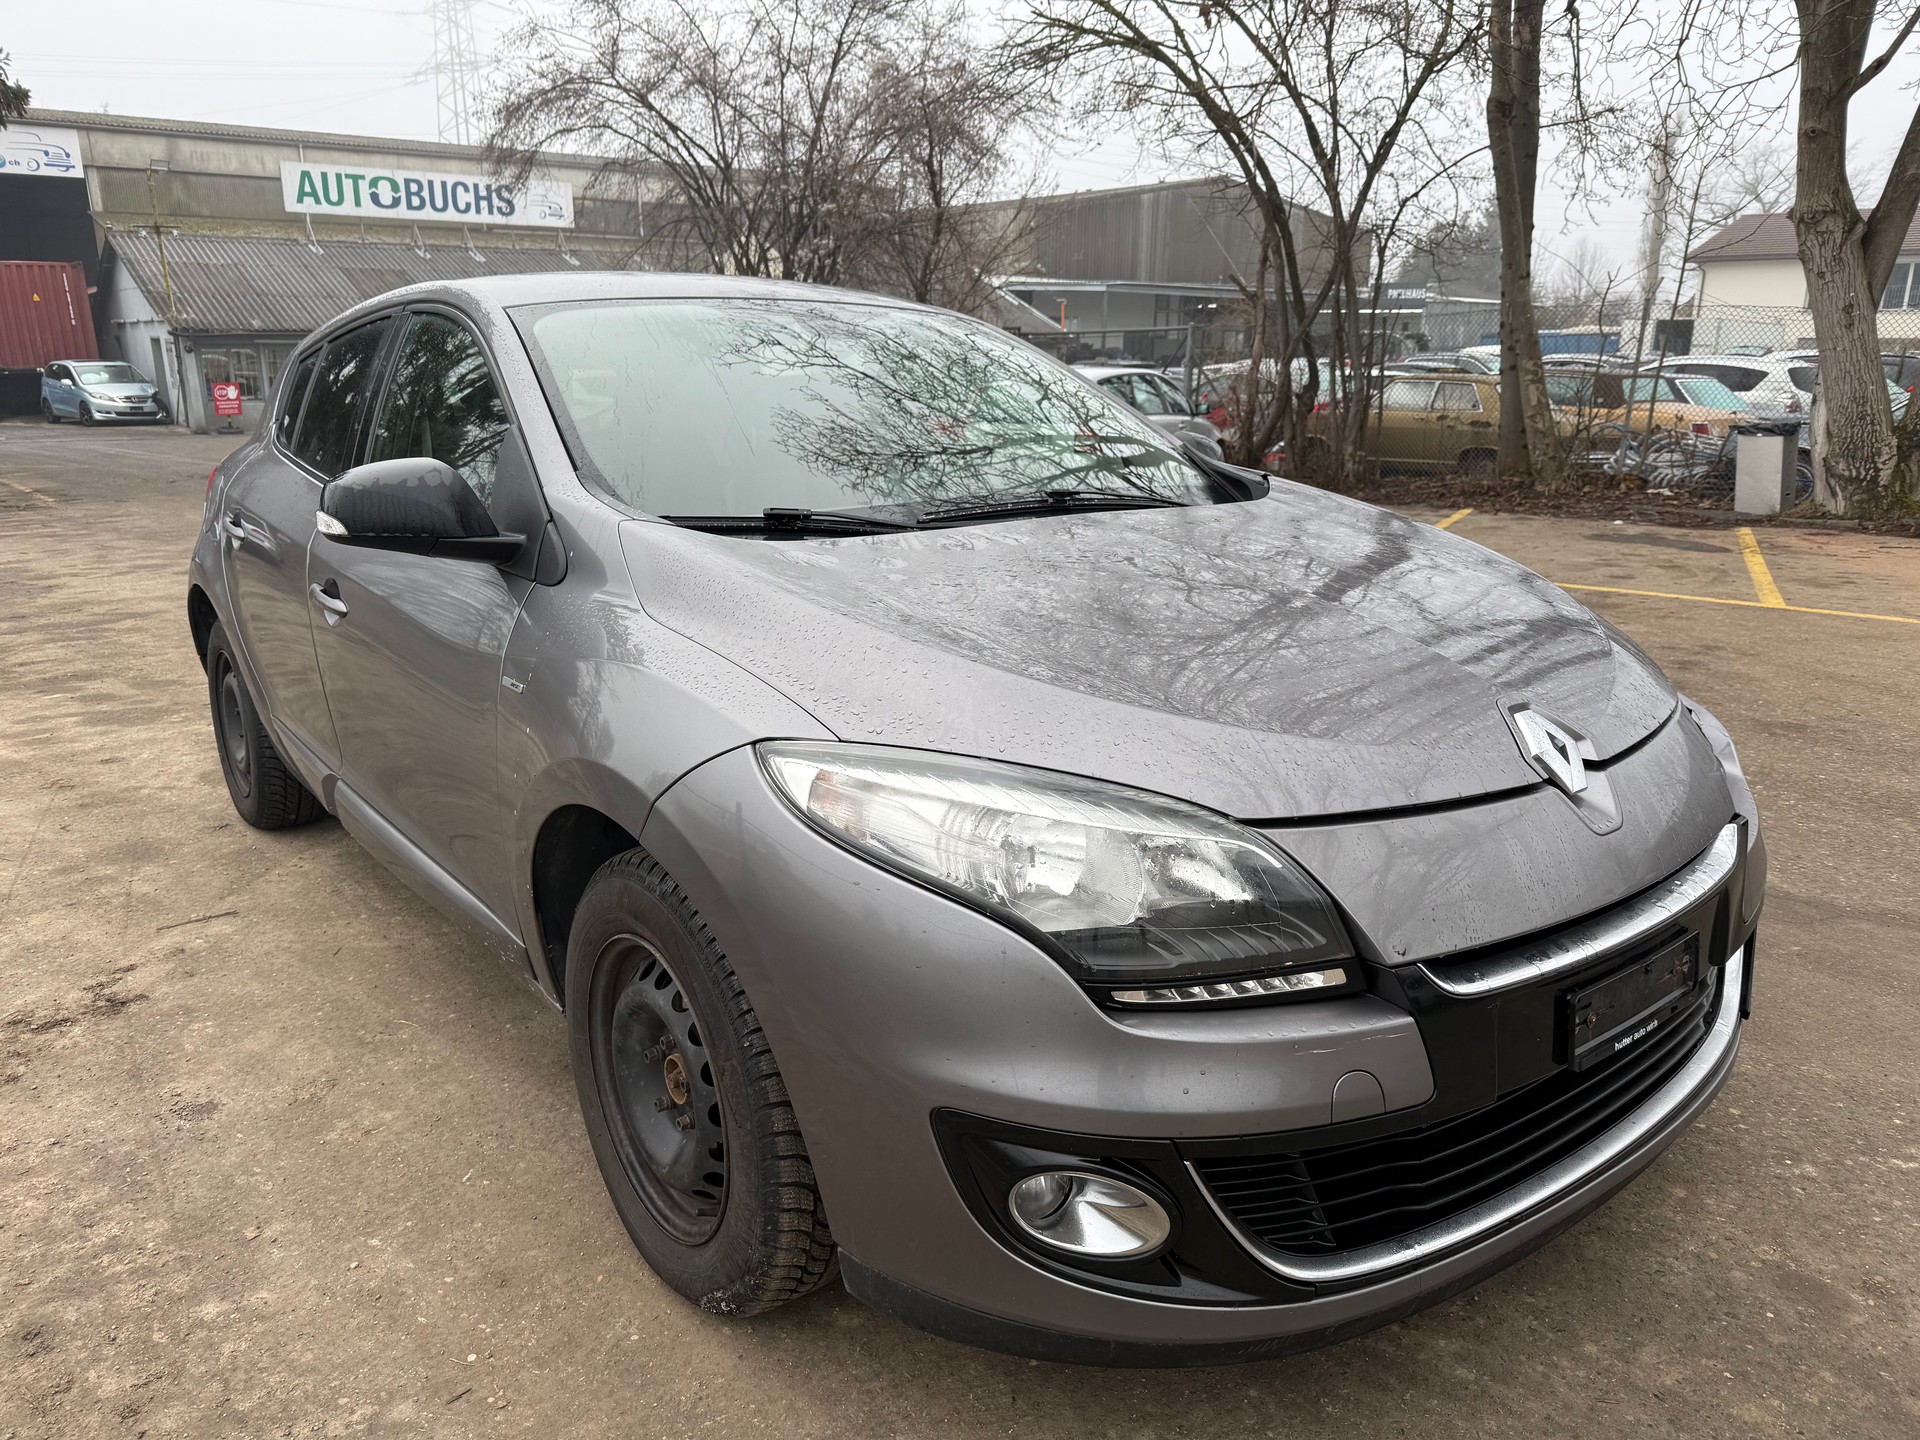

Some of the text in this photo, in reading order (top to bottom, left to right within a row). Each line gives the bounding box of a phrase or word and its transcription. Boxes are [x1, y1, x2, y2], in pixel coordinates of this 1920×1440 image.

[296, 170, 516, 218] AUTOBUCHS
[1614, 1035, 1633, 1051] hutter
[1633, 1027, 1646, 1040] auto
